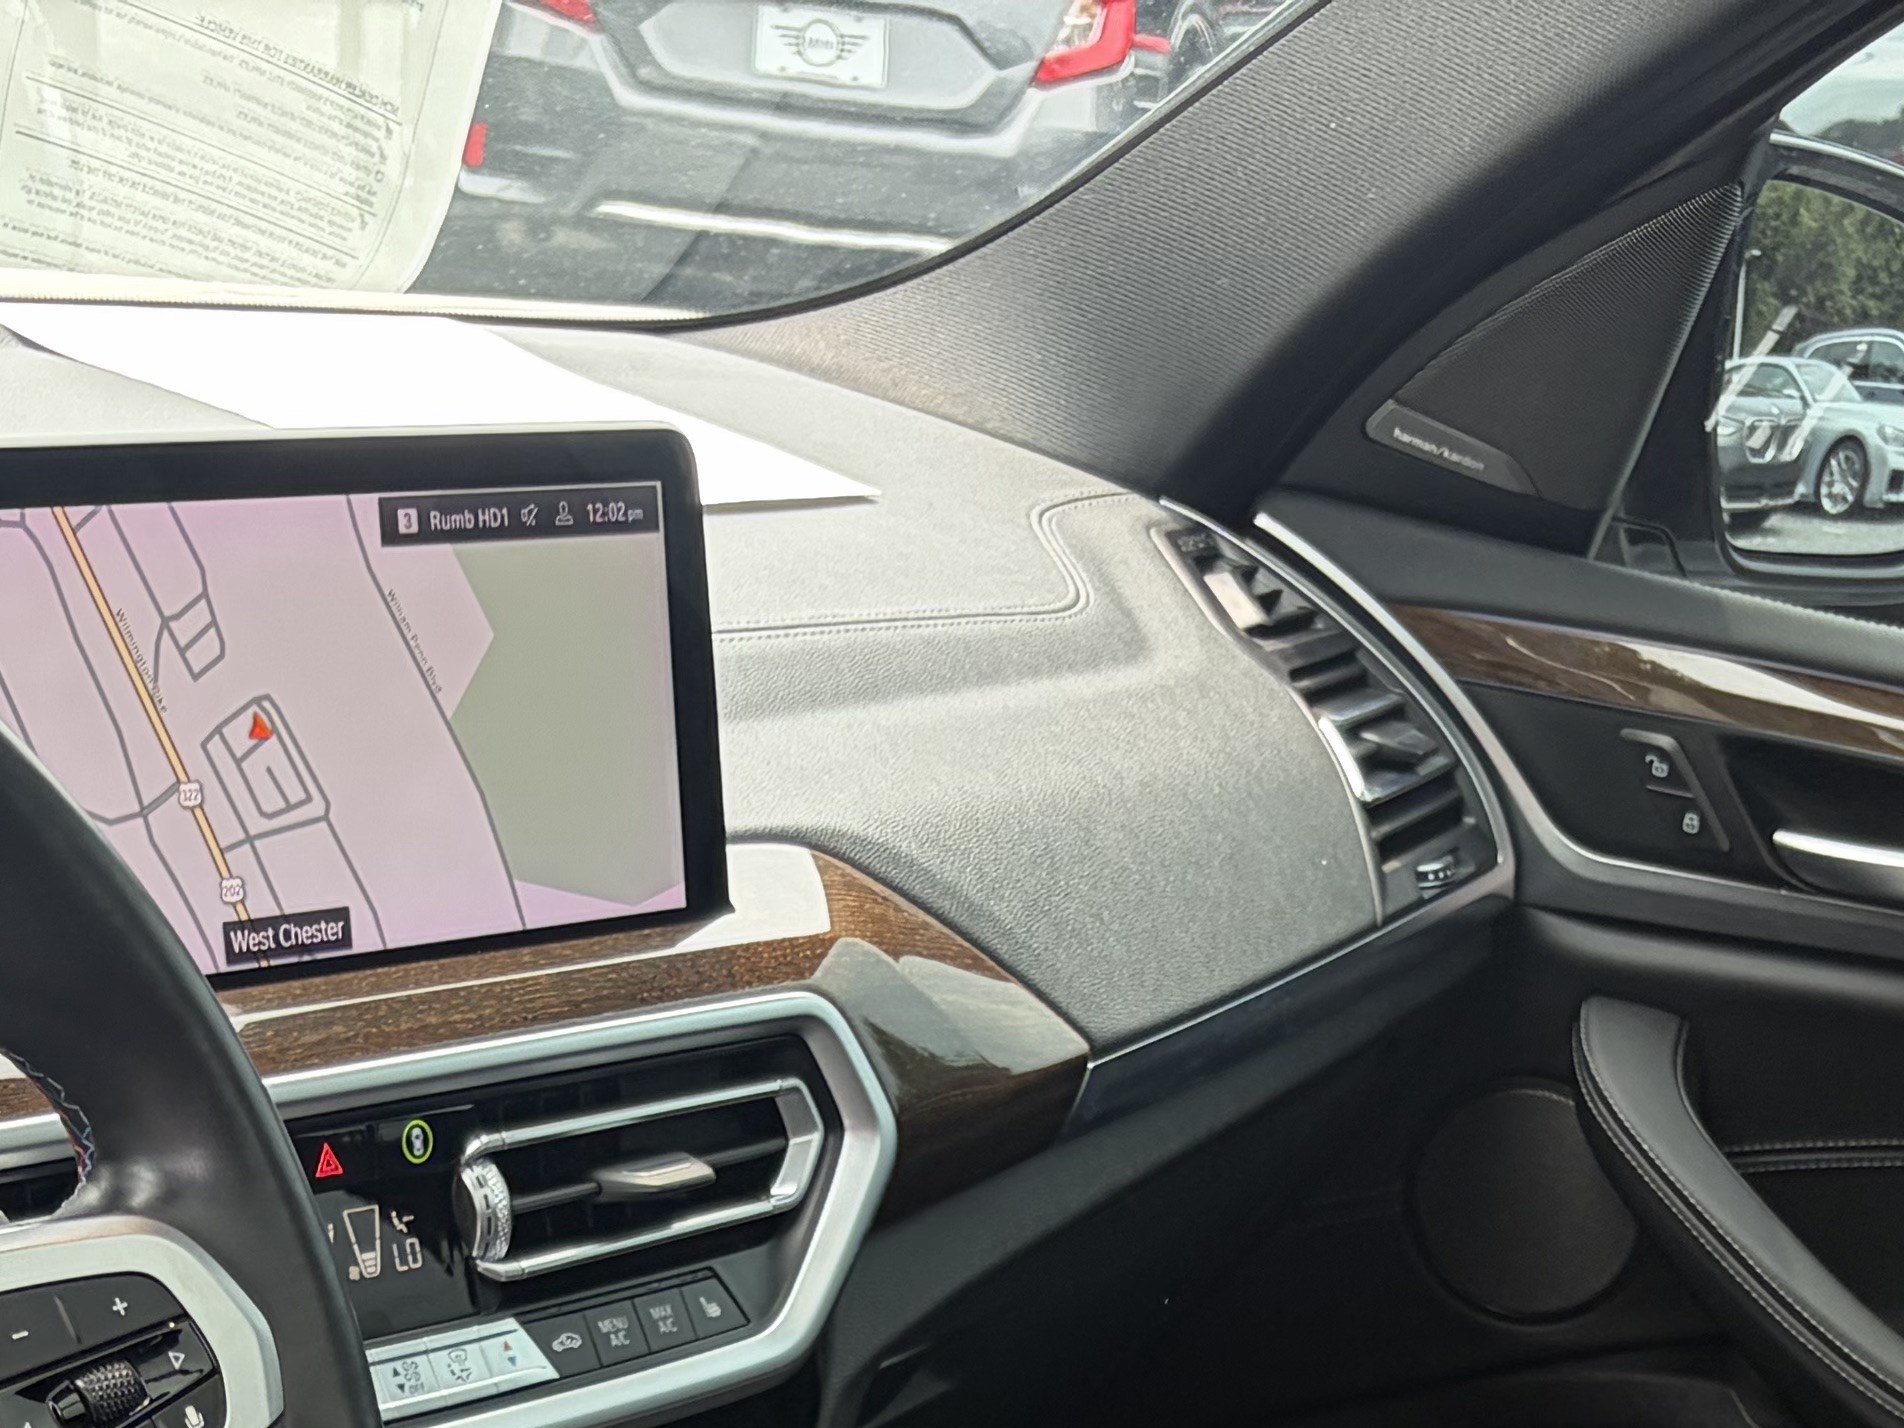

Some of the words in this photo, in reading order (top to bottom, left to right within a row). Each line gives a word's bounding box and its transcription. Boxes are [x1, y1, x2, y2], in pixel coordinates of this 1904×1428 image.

[430, 508, 475, 532] Rumb
[478, 507, 510, 528] HD1
[586, 501, 626, 524] 12:02
[230, 928, 276, 955] West
[278, 920, 345, 948] Chester
[597, 1316, 629, 1333] MENU
